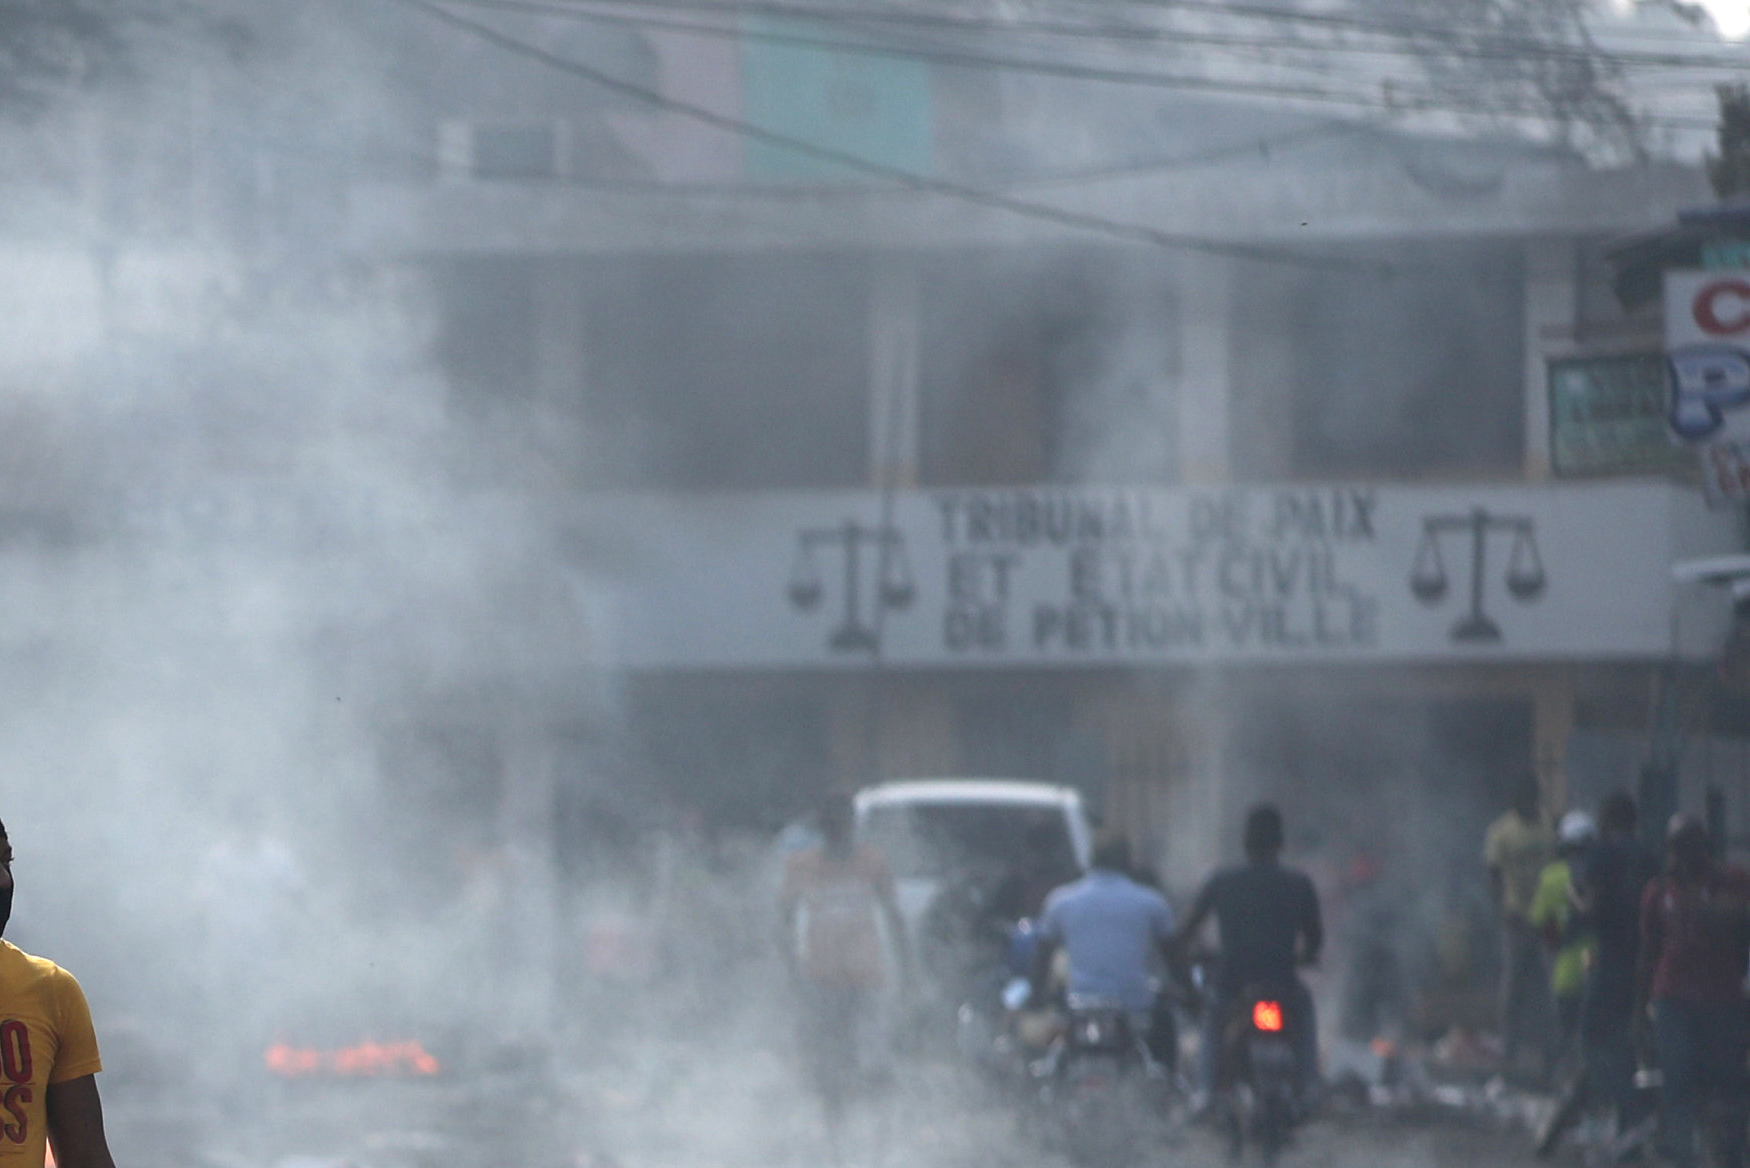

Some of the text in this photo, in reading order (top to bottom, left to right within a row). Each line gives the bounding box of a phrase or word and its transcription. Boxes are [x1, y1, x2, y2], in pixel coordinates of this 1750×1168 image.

[934, 486, 1378, 545] TRIBUNAL DE PAIX
[947, 551, 1019, 599] ET
[942, 604, 1007, 651] DE
